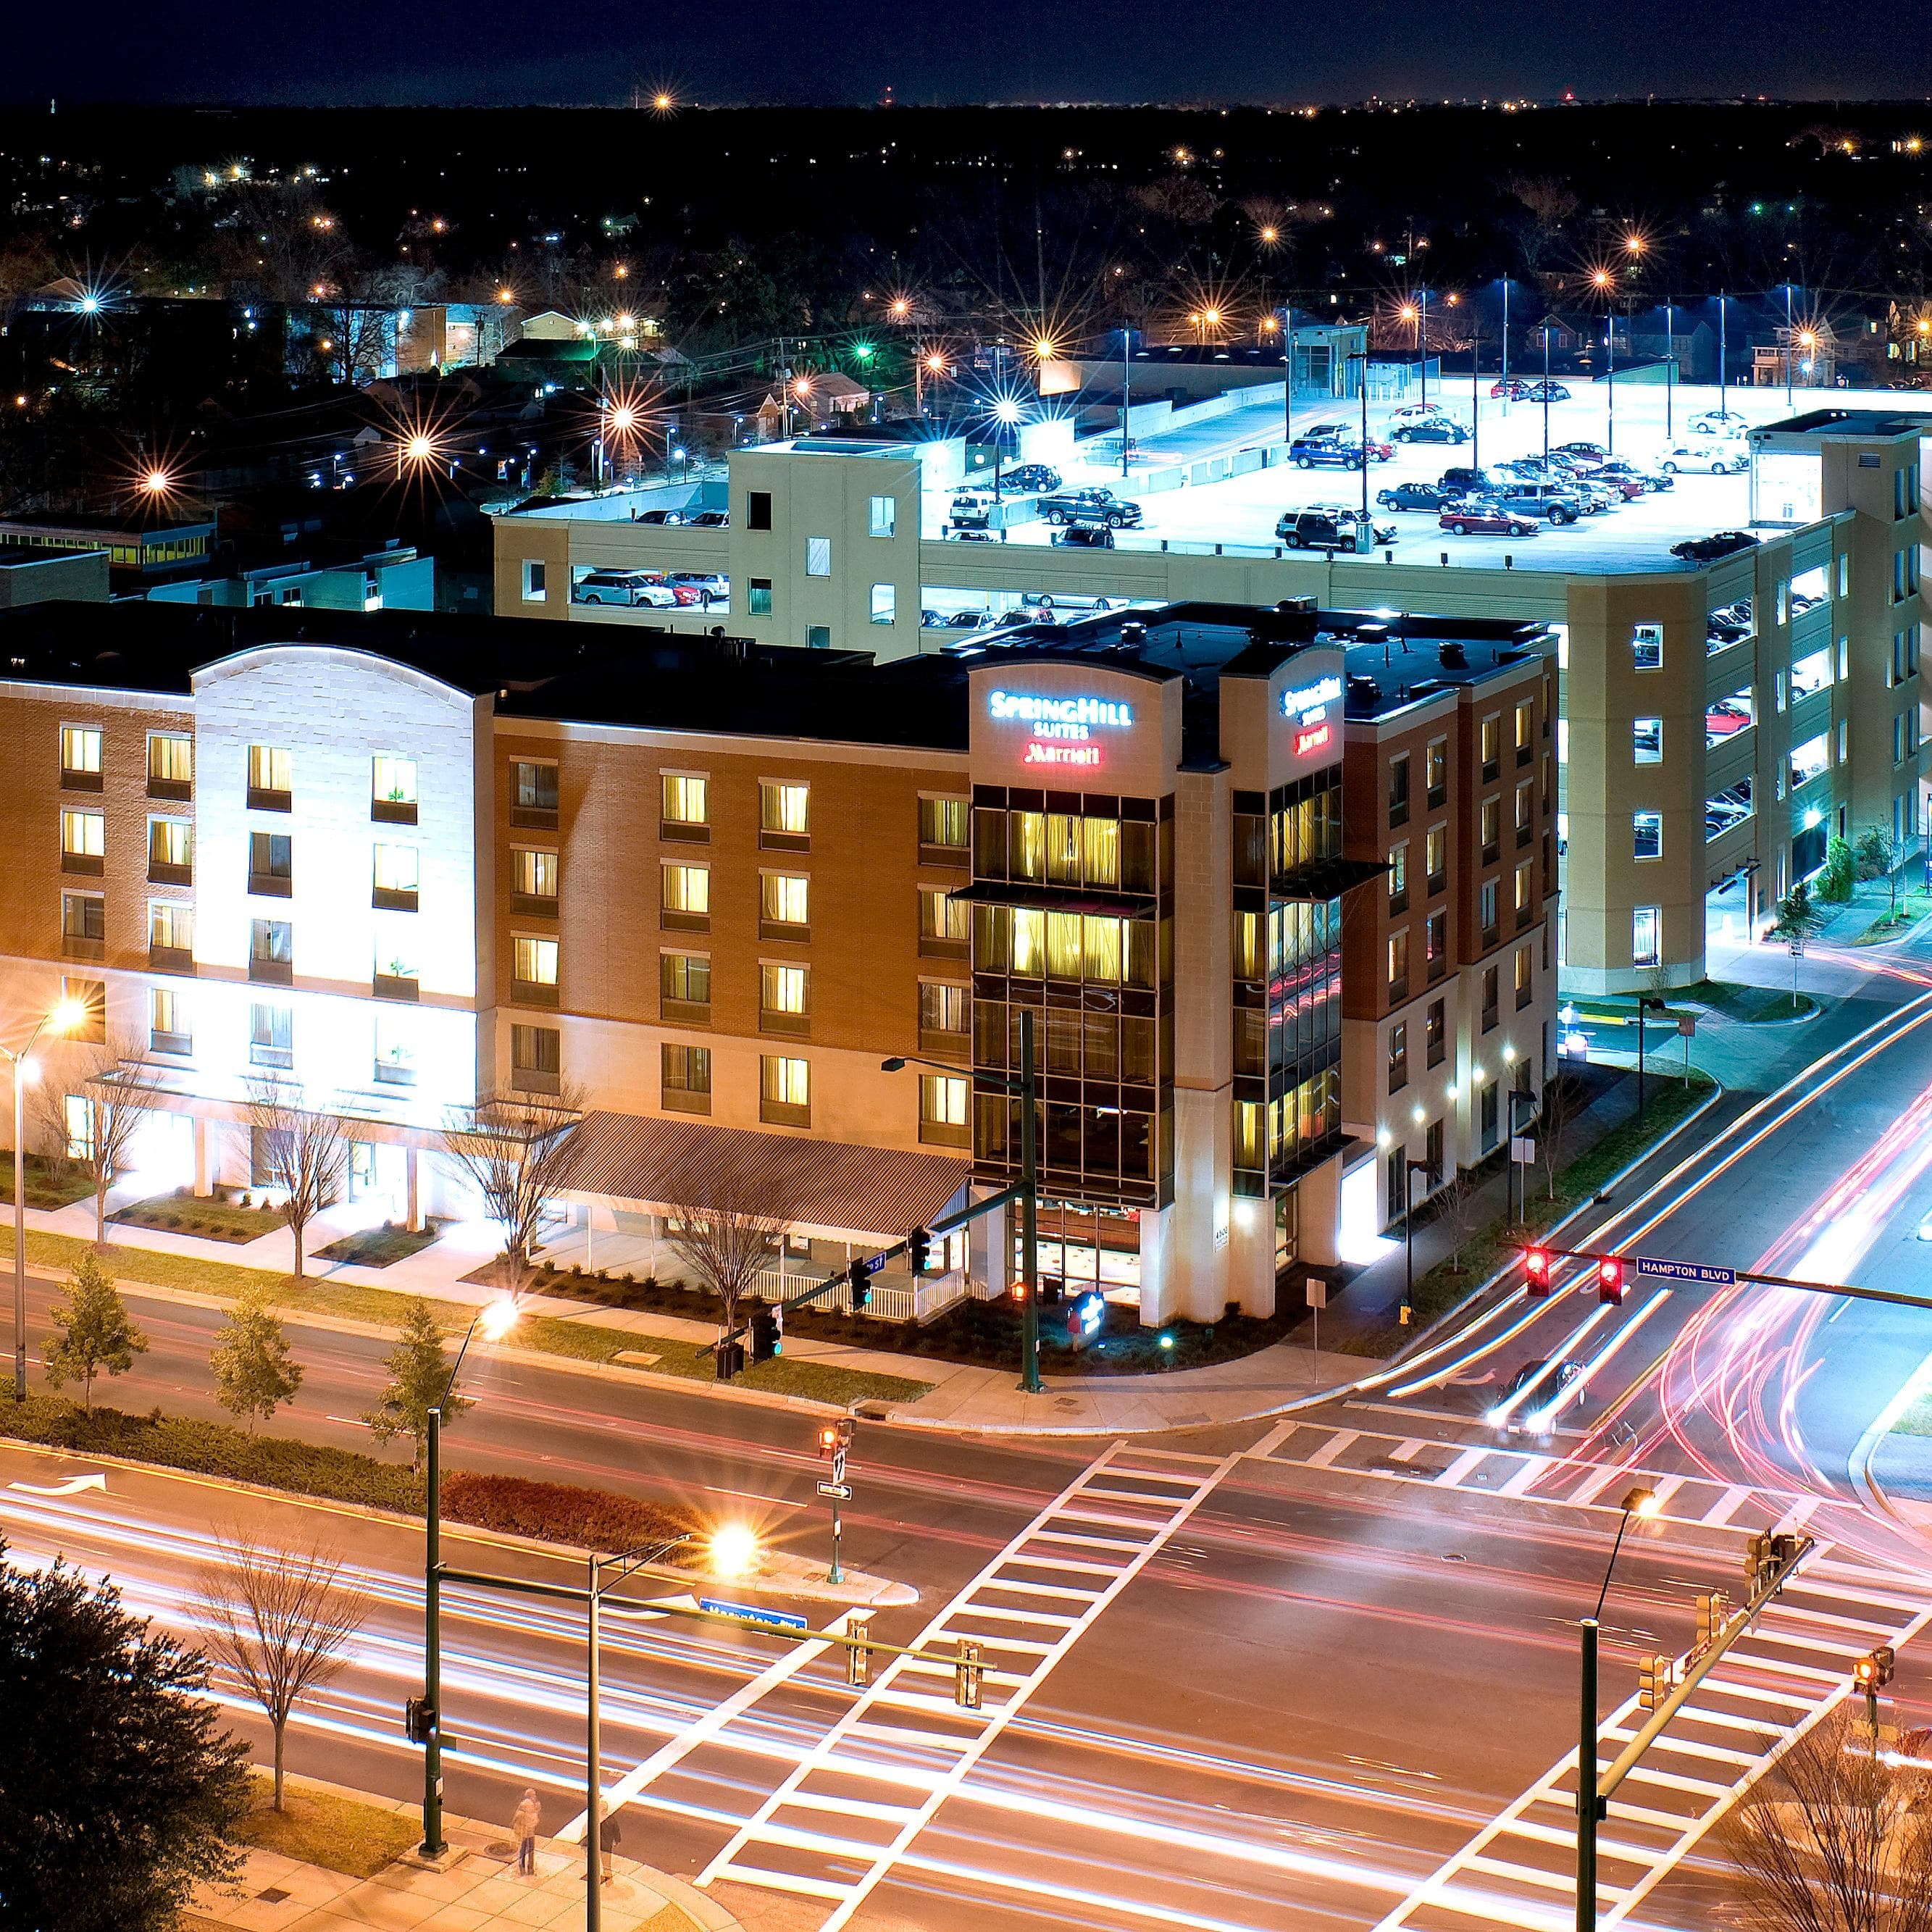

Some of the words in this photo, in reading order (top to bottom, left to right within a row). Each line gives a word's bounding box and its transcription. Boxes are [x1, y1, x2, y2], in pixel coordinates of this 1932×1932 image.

[990, 690, 1132, 727] SPRINGHILL
[1033, 721, 1090, 740] SUITES
[1642, 1262, 1697, 1277] HAMPTON
[1702, 1268, 1730, 1281] BLVD
